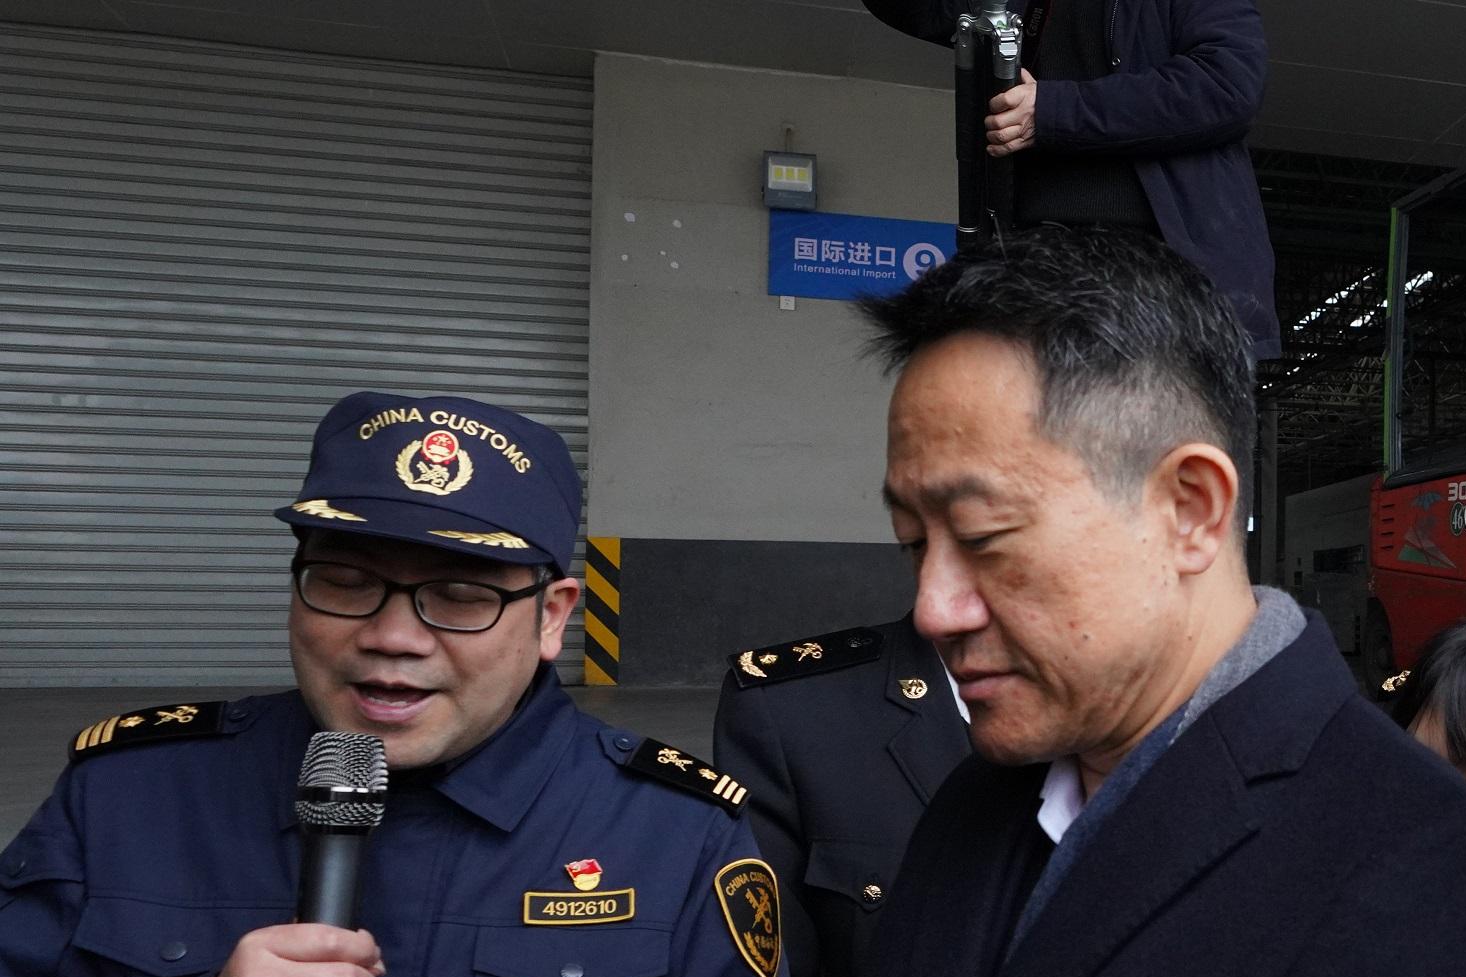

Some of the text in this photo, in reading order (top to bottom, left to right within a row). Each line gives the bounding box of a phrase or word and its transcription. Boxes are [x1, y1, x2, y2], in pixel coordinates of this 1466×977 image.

[793, 237, 896, 267] 国际进口
[793, 263, 896, 280] International Import
[359, 407, 532, 474] CHINA CUSTOMS
[725, 872, 750, 896] CHINA
[542, 899, 617, 916] 4912610
